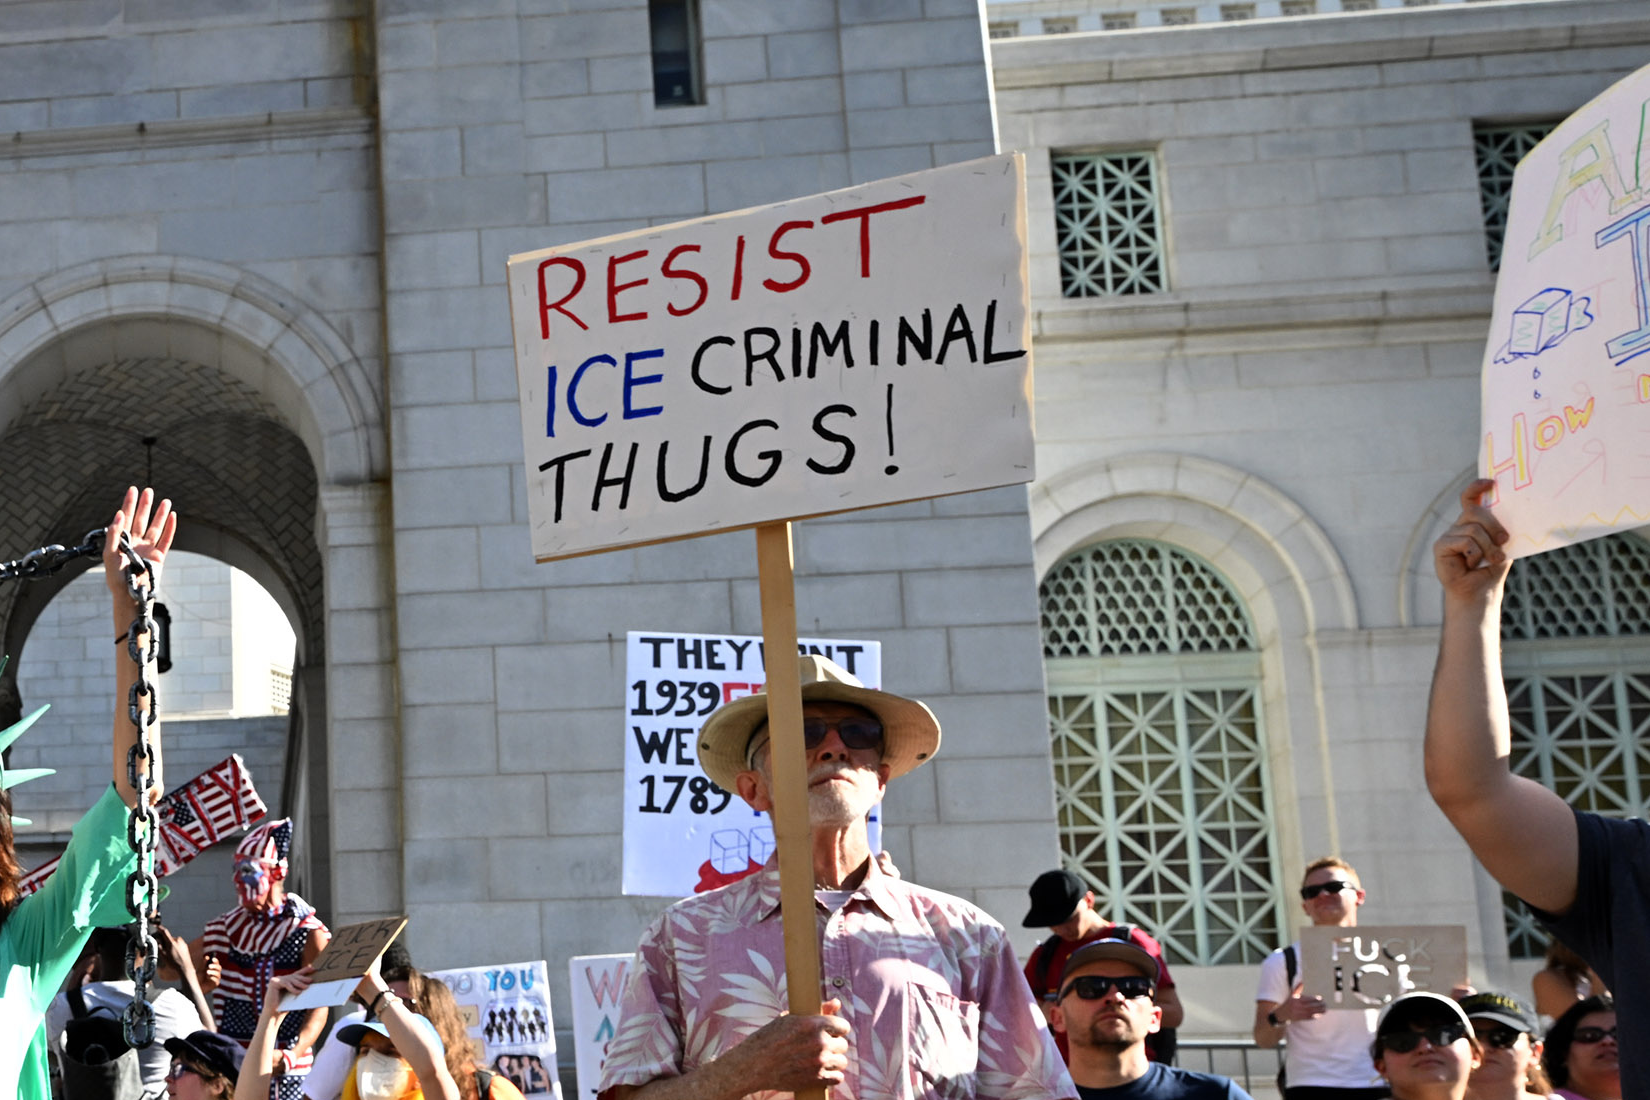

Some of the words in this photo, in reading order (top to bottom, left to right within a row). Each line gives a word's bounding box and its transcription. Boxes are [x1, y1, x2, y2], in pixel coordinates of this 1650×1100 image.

[537, 195, 926, 339] RESIST
[545, 348, 664, 437] ICE
[690, 299, 1028, 395] CRIMINAL
[539, 382, 900, 524] THUGS!
[639, 638, 752, 670] THEY
[631, 680, 720, 716] 1939
[633, 726, 700, 765] WE
[639, 775, 732, 815] 1789
[331, 920, 396, 947] FUCK
[1332, 935, 1434, 963] FUCK
[316, 944, 374, 972] ICE
[485, 969, 534, 991] YOU
[1334, 964, 1432, 1005] ICE
